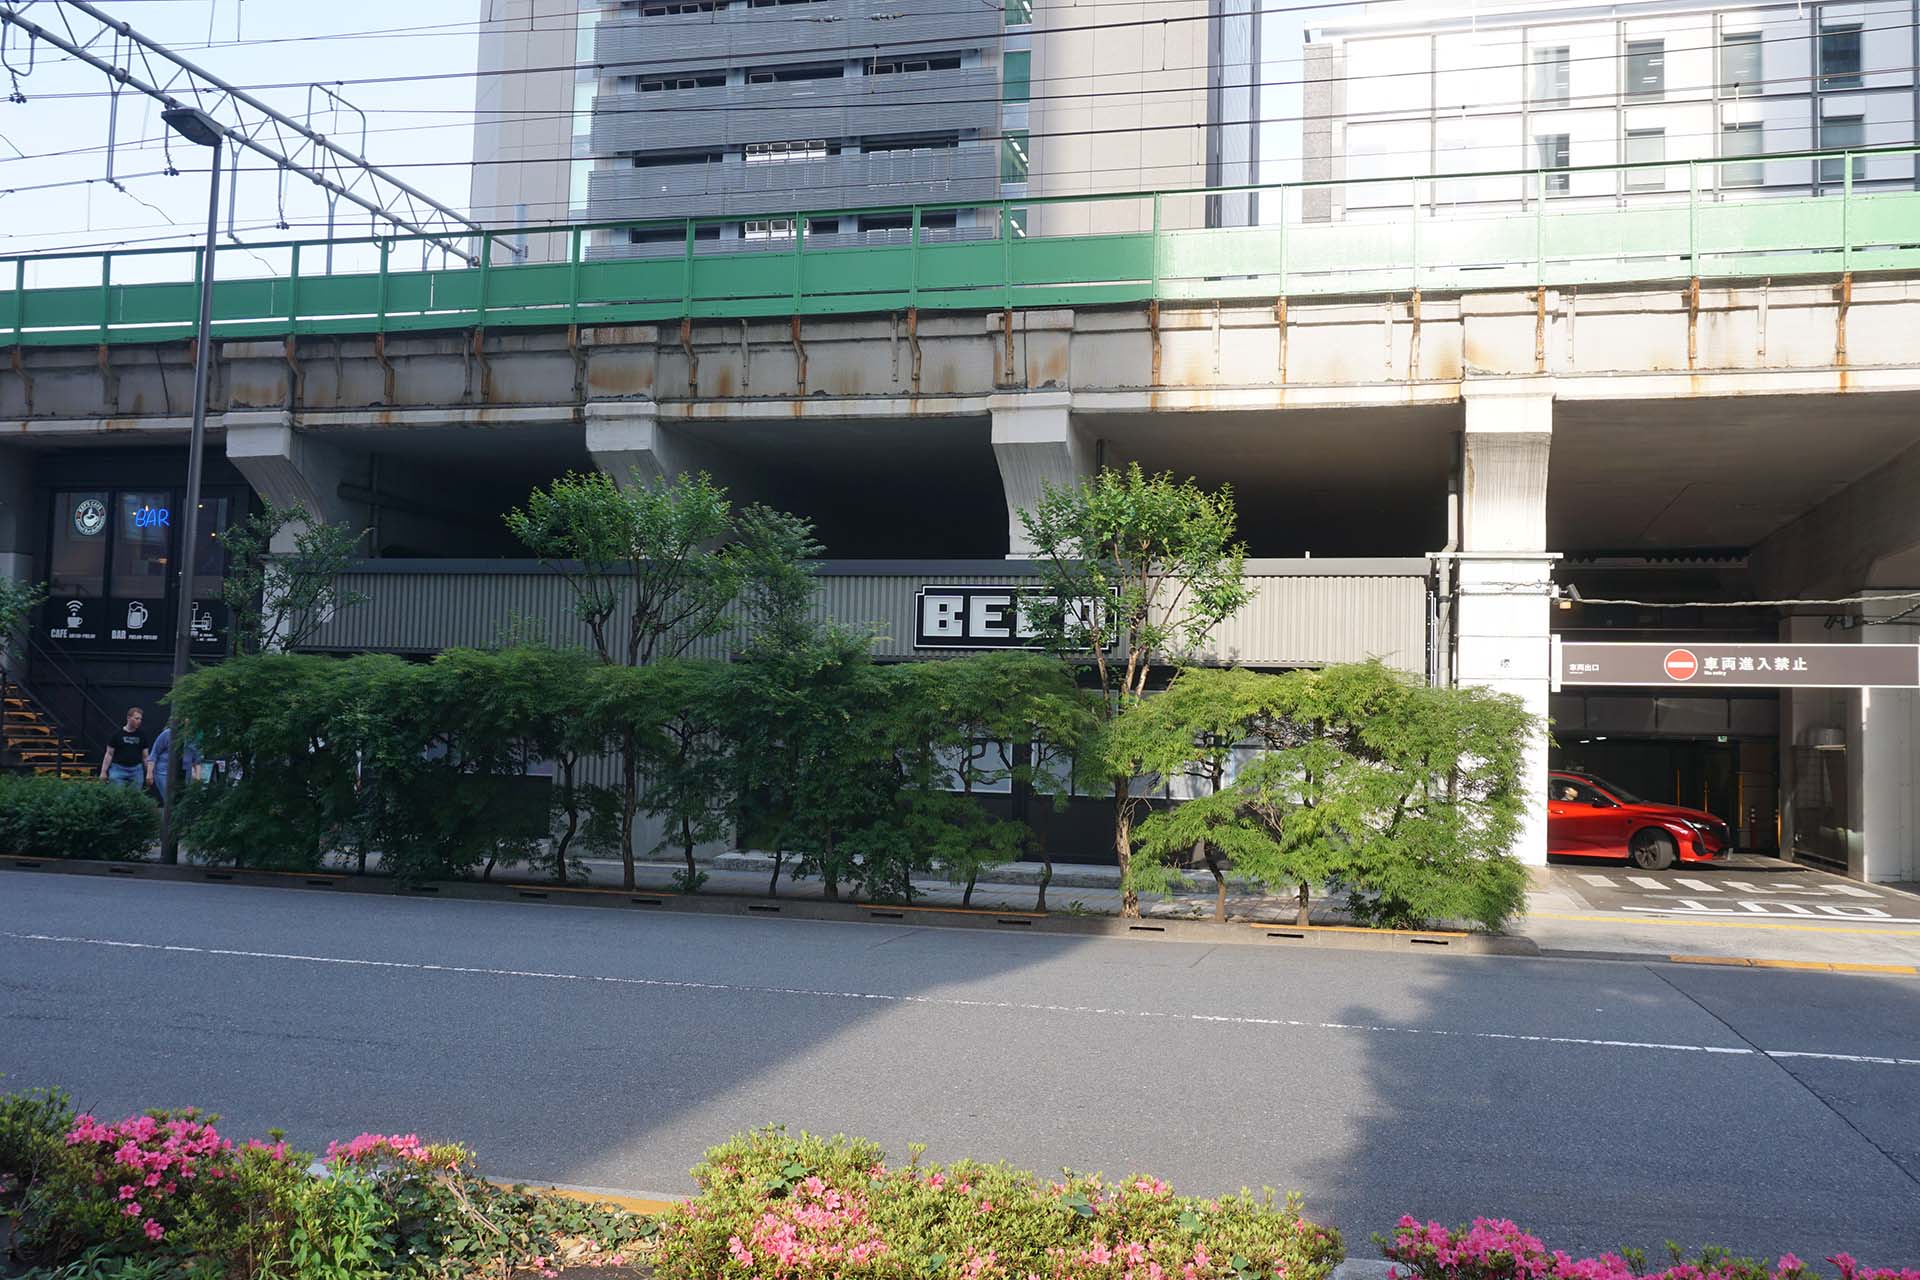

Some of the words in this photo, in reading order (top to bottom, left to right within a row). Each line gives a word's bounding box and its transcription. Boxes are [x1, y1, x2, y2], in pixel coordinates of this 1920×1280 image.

[135, 508, 170, 527] BAR
[50, 628, 68, 639] CAFE
[111, 630, 127, 640] BAR
[1703, 656, 1808, 671] 車両進入禁止
